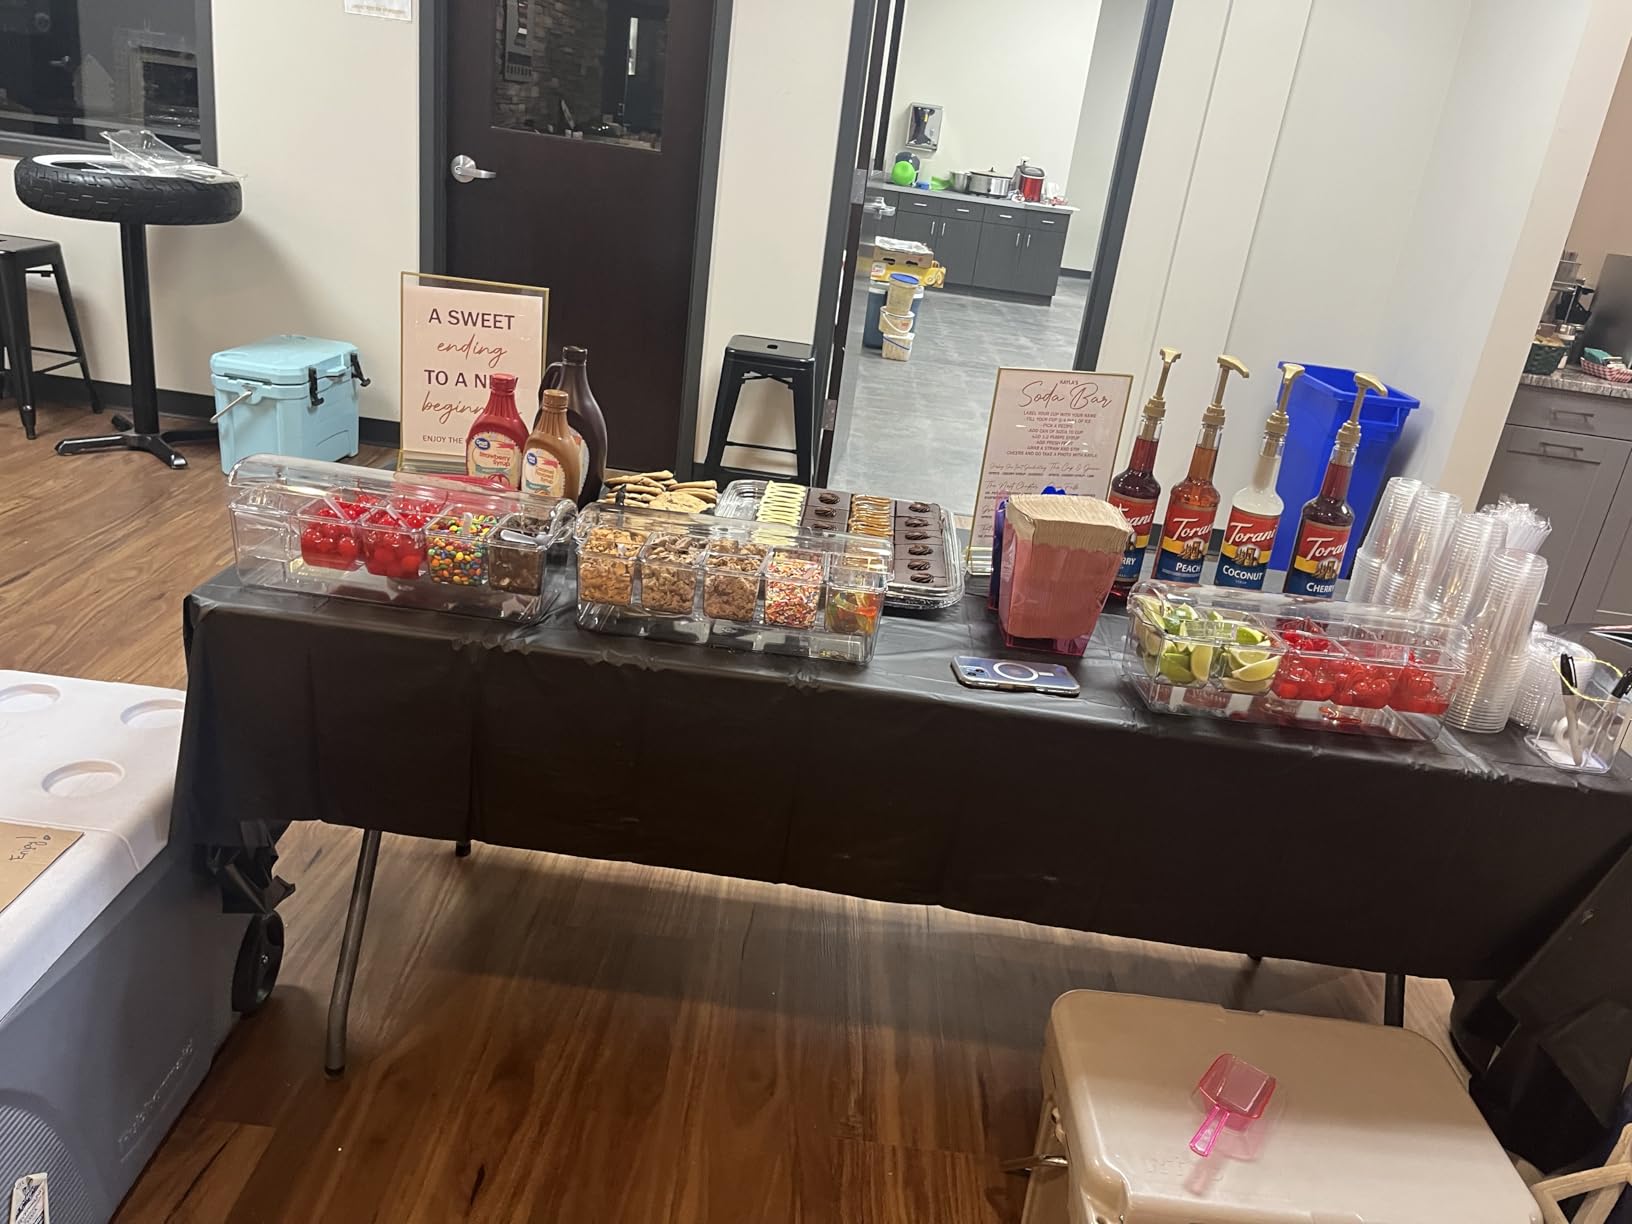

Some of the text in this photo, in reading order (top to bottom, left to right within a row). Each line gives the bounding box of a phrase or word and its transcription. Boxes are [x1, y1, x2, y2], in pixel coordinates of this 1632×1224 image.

[428, 308, 516, 330] A SWEET
[437, 334, 508, 368] ending
[424, 369, 448, 386] TO
[454, 372, 468, 388] A
[1018, 380, 1112, 410] Soda Bar
[423, 435, 446, 444] ENJOY
[1228, 522, 1278, 544] Torani
[1222, 565, 1264, 580] COCONUT
